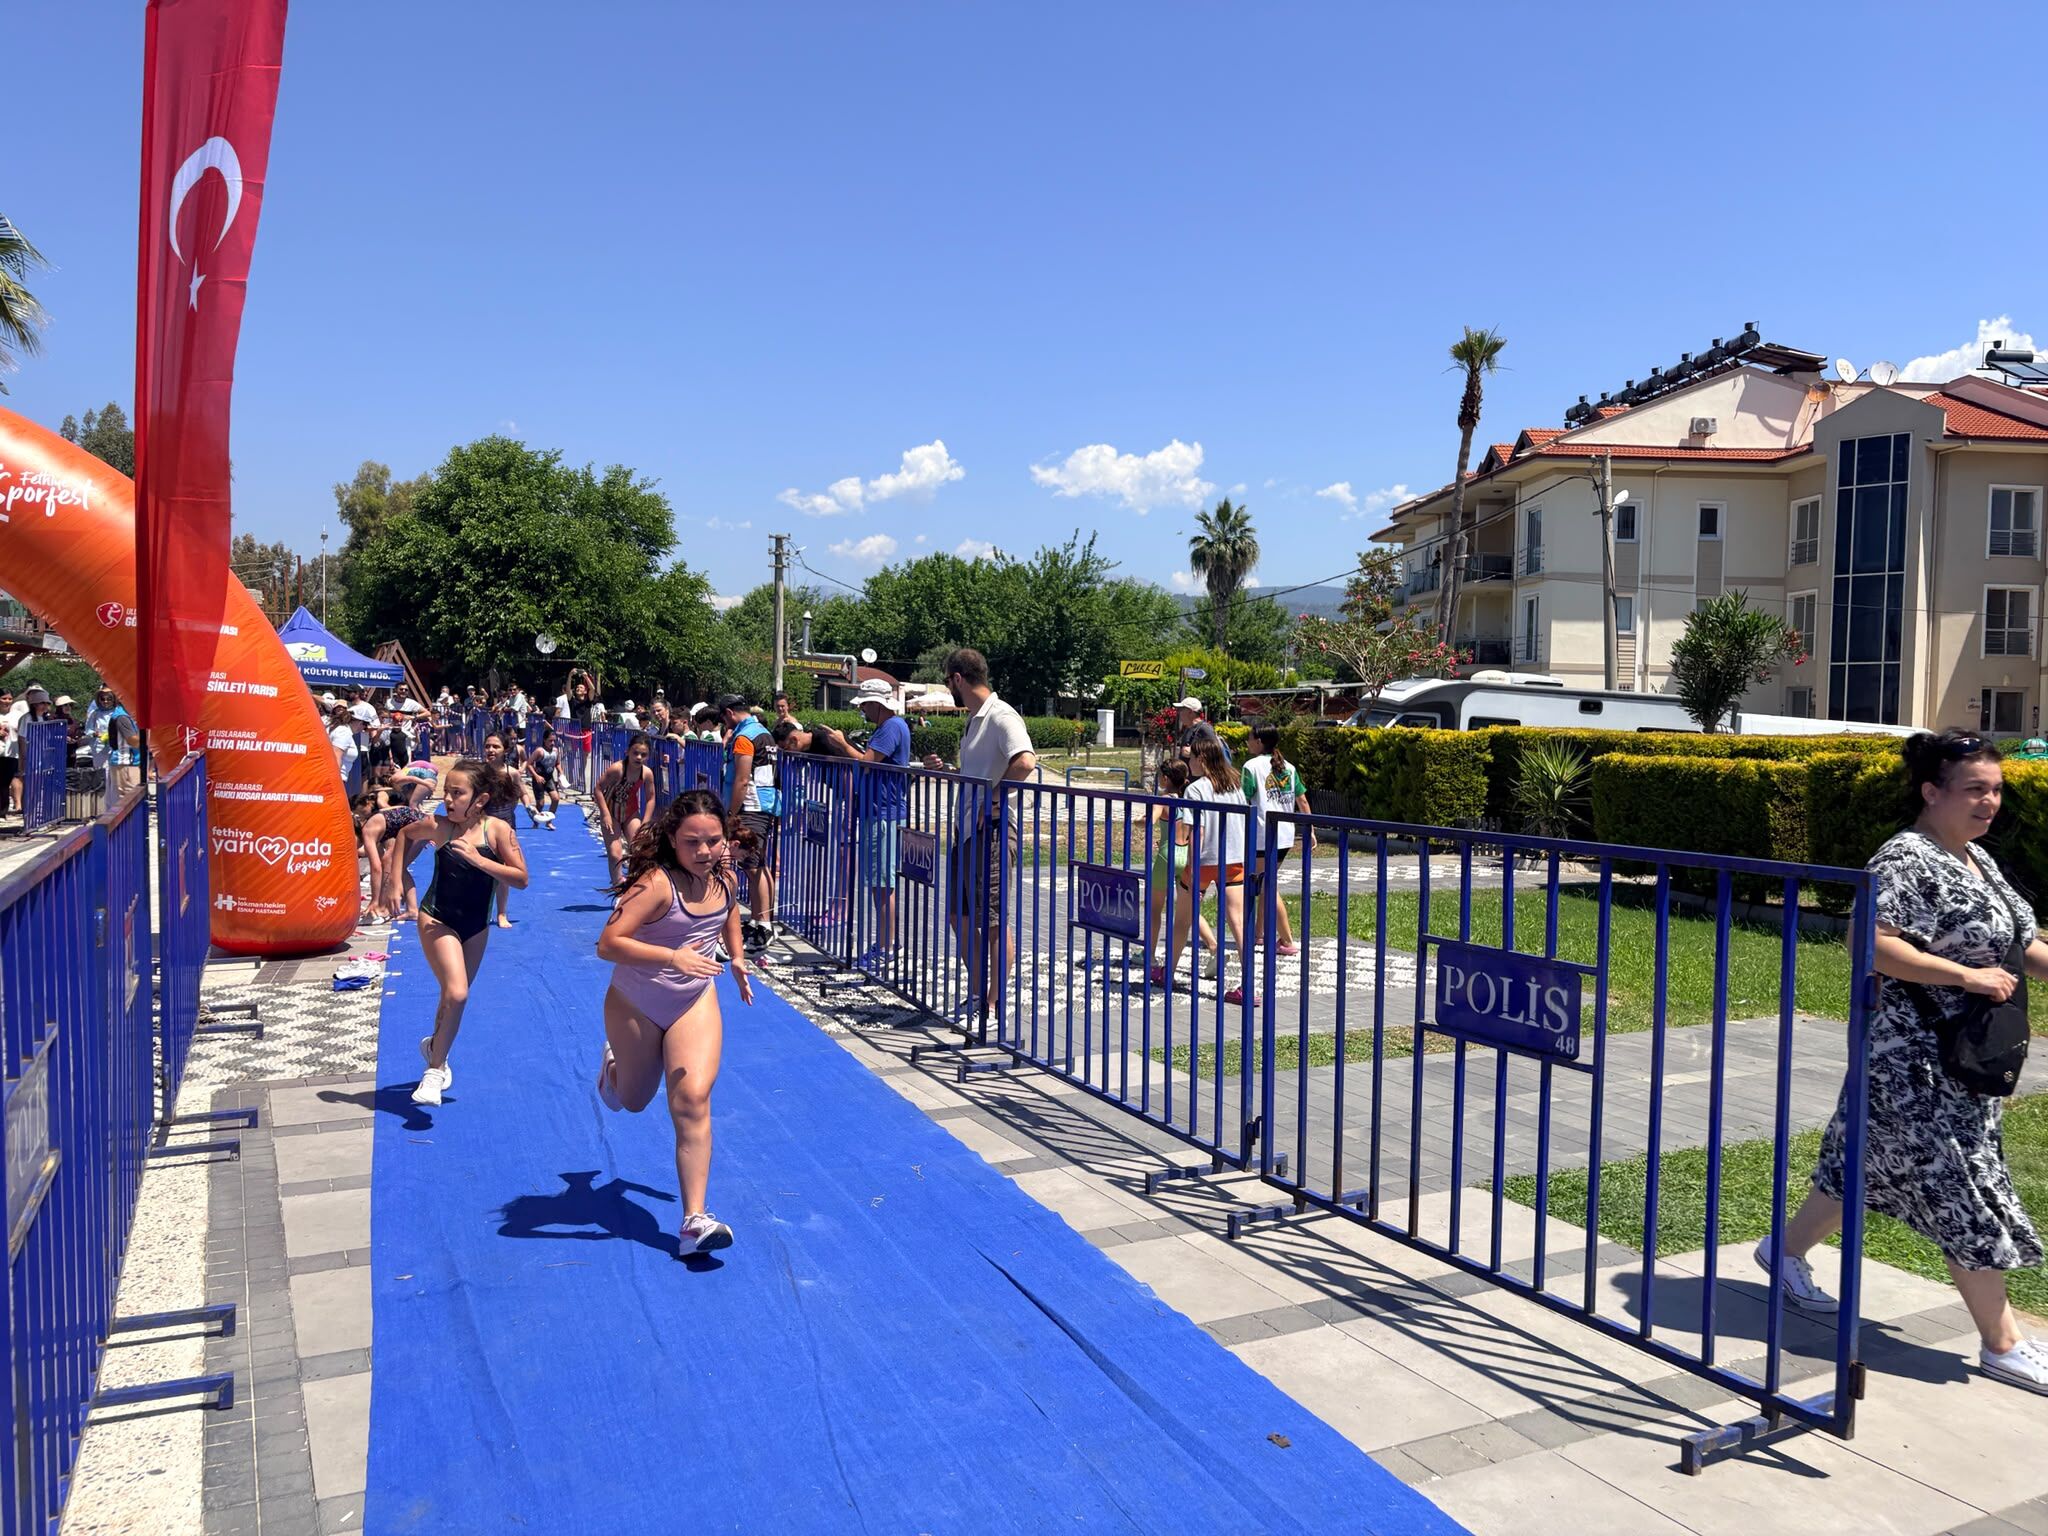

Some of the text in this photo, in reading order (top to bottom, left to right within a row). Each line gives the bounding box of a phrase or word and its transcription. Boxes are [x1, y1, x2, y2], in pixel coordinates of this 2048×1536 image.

[303, 666, 392, 680] KÜLTÜR İŞLERİ MÜD.
[247, 683, 279, 697] YARIŞI
[208, 729, 258, 739] ULUSLARARASI
[206, 736, 308, 755] LİKYA HALK OYUNLARI
[260, 792, 289, 801] KARATE
[212, 826, 254, 840] fethiye
[1080, 880, 1135, 920] POLİS
[1442, 964, 1570, 1034] POLİS
[1554, 1034, 1577, 1056] 48
